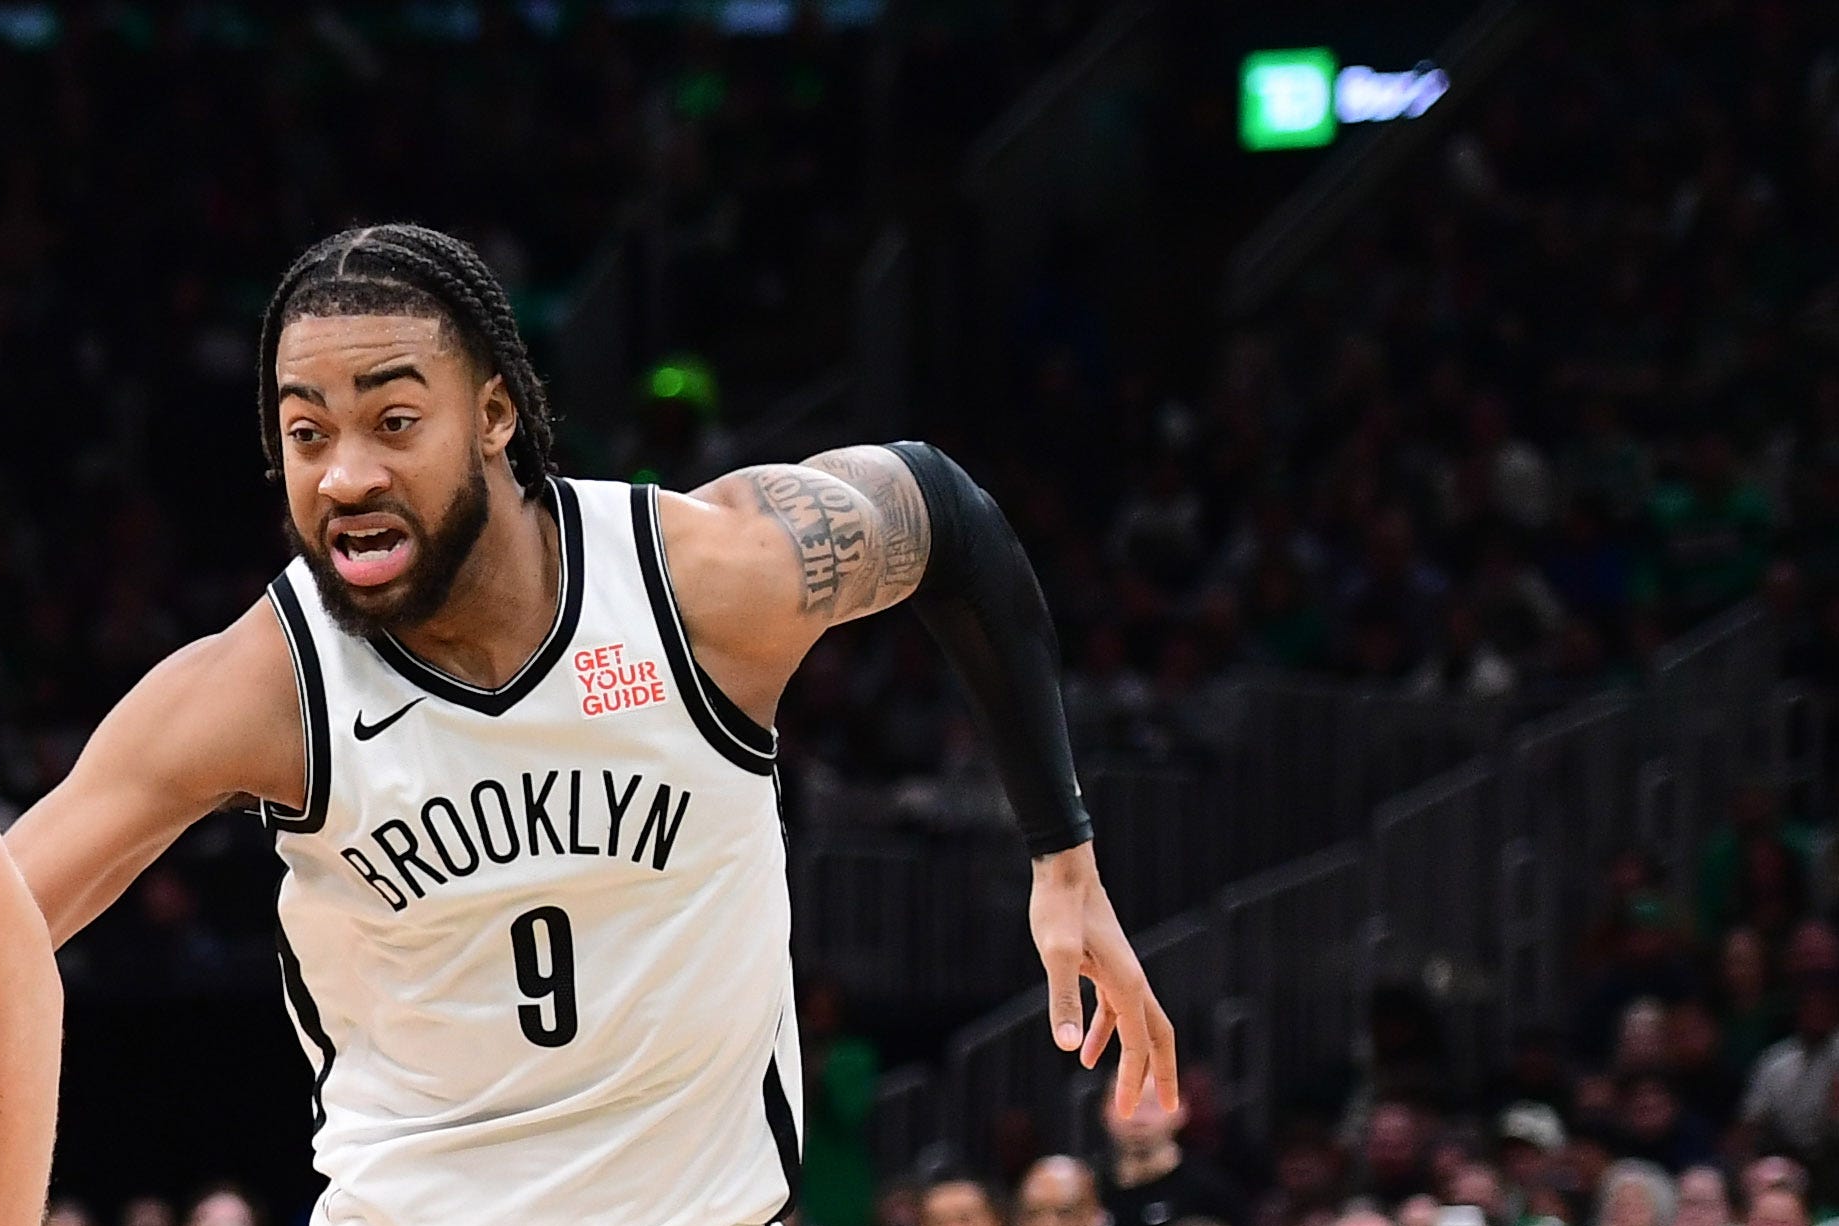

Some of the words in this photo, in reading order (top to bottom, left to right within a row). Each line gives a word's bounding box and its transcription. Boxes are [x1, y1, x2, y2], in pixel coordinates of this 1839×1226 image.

[574, 643, 624, 672] GET
[578, 661, 658, 694] YOUR
[582, 681, 666, 716] GUIDE
[341, 770, 691, 912] BROOKLYN
[509, 905, 578, 1048] 9
